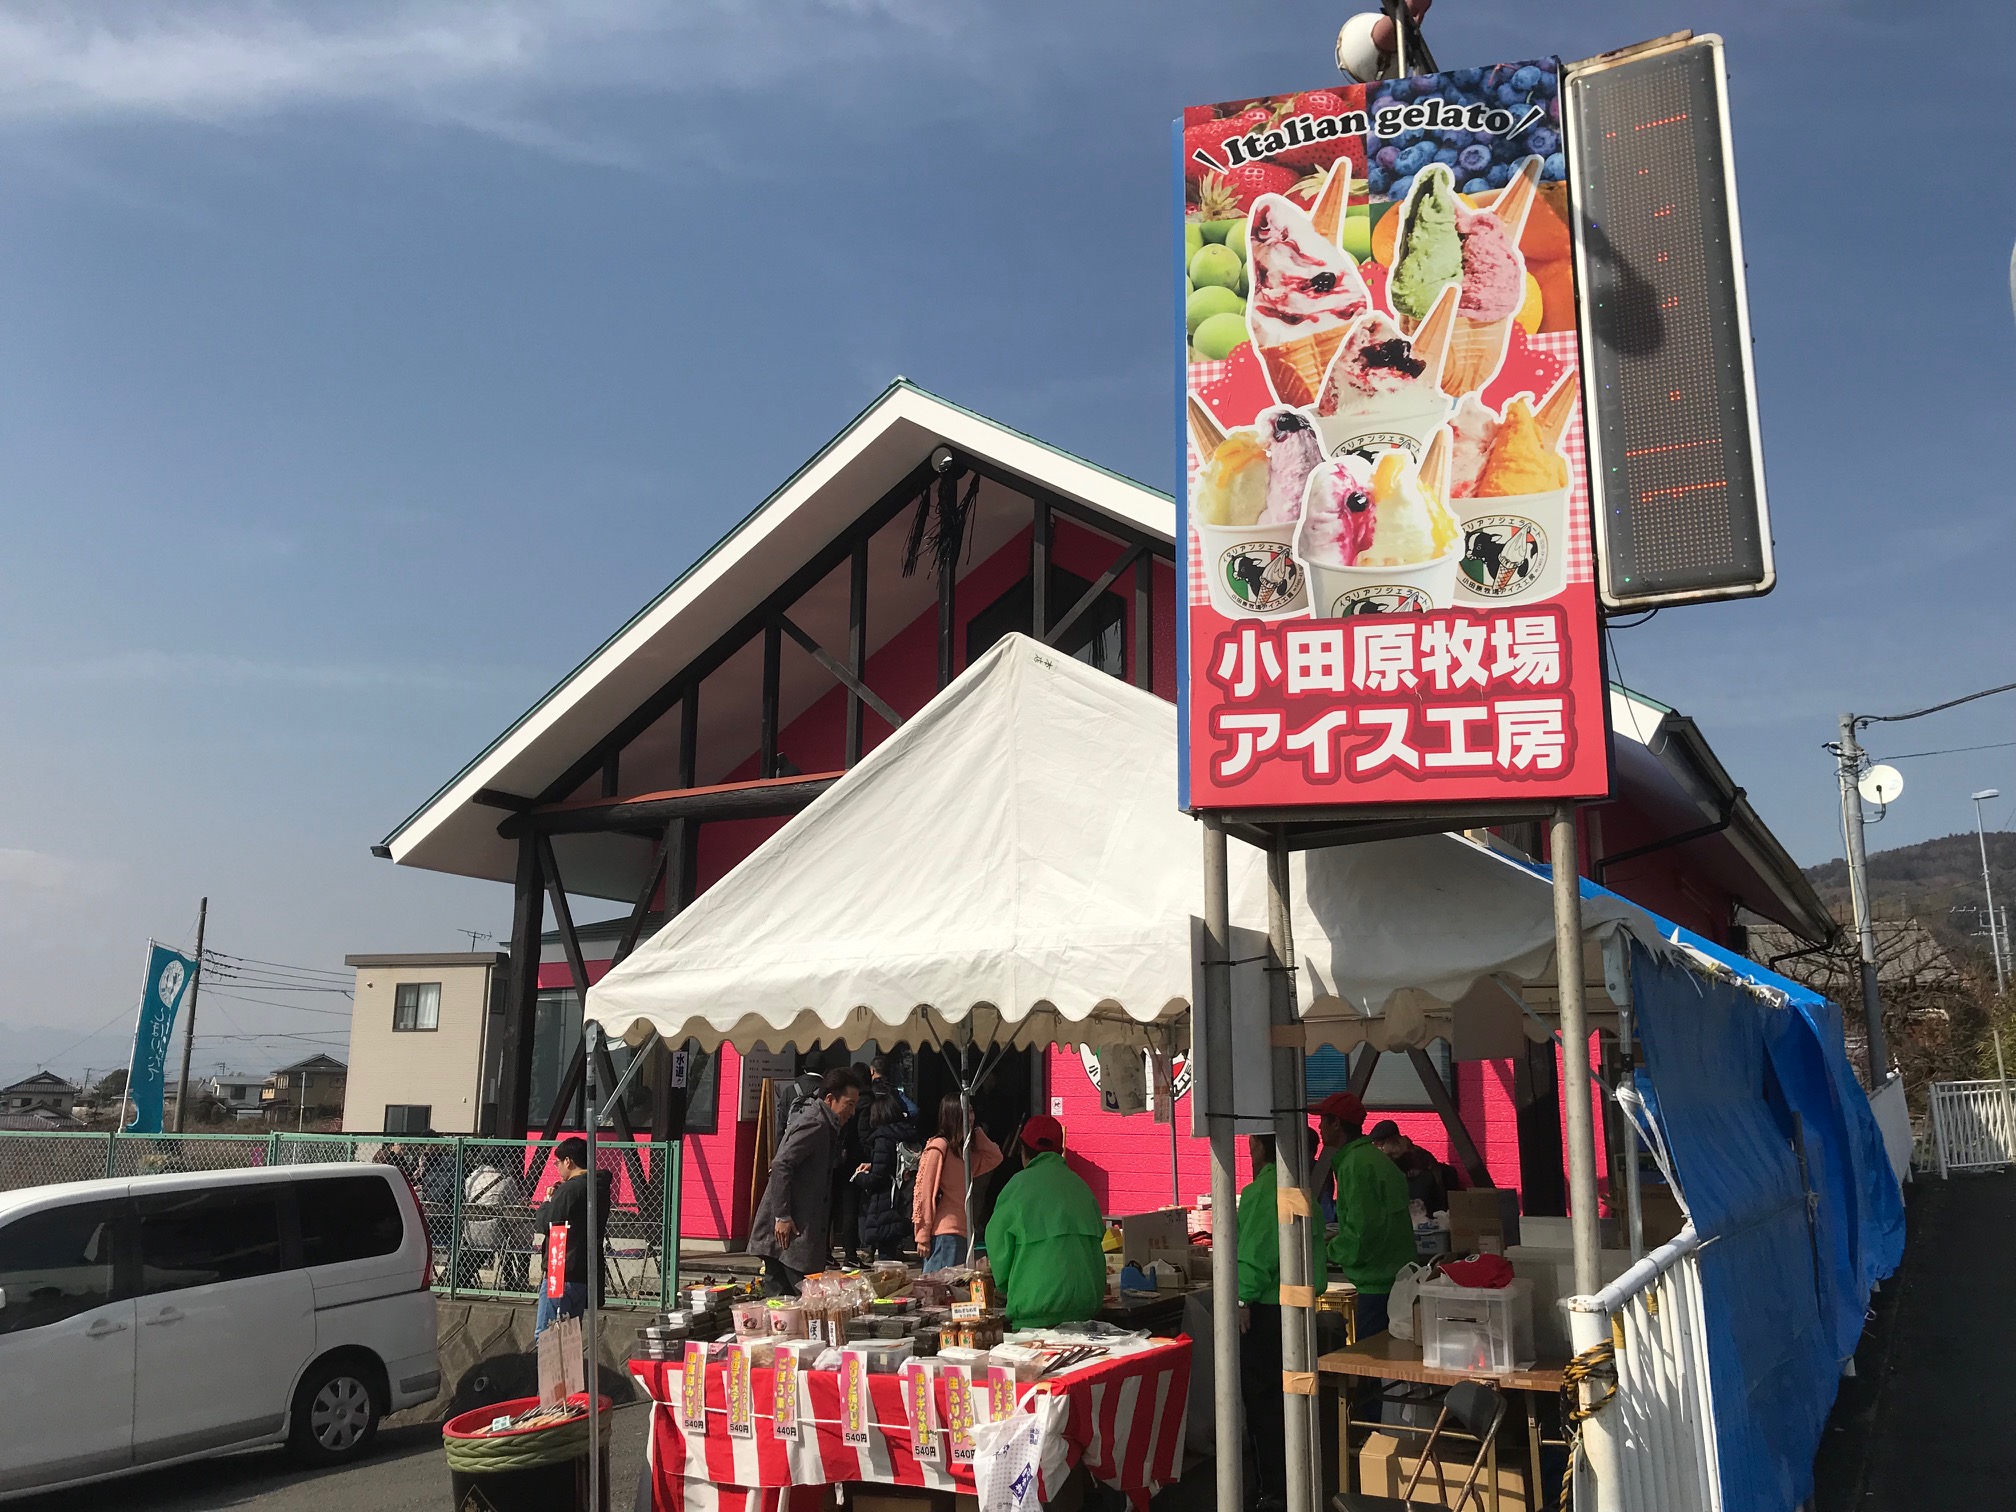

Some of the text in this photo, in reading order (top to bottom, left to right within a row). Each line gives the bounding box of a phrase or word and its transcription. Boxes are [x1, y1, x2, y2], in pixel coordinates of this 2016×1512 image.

[1225, 101, 1511, 166] Italian gelato
[1217, 615, 1560, 698] 小田原牧場
[1219, 698, 1566, 777] アイス工房
[787, 1356, 797, 1407] きんぴら
[960, 1375, 974, 1428] しょうが
[684, 1420, 704, 1429] 540円
[729, 1424, 749, 1434] 540円
[776, 1426, 797, 1436] 440円
[845, 1433, 867, 1443] 540円
[914, 1446, 936, 1457] 540円
